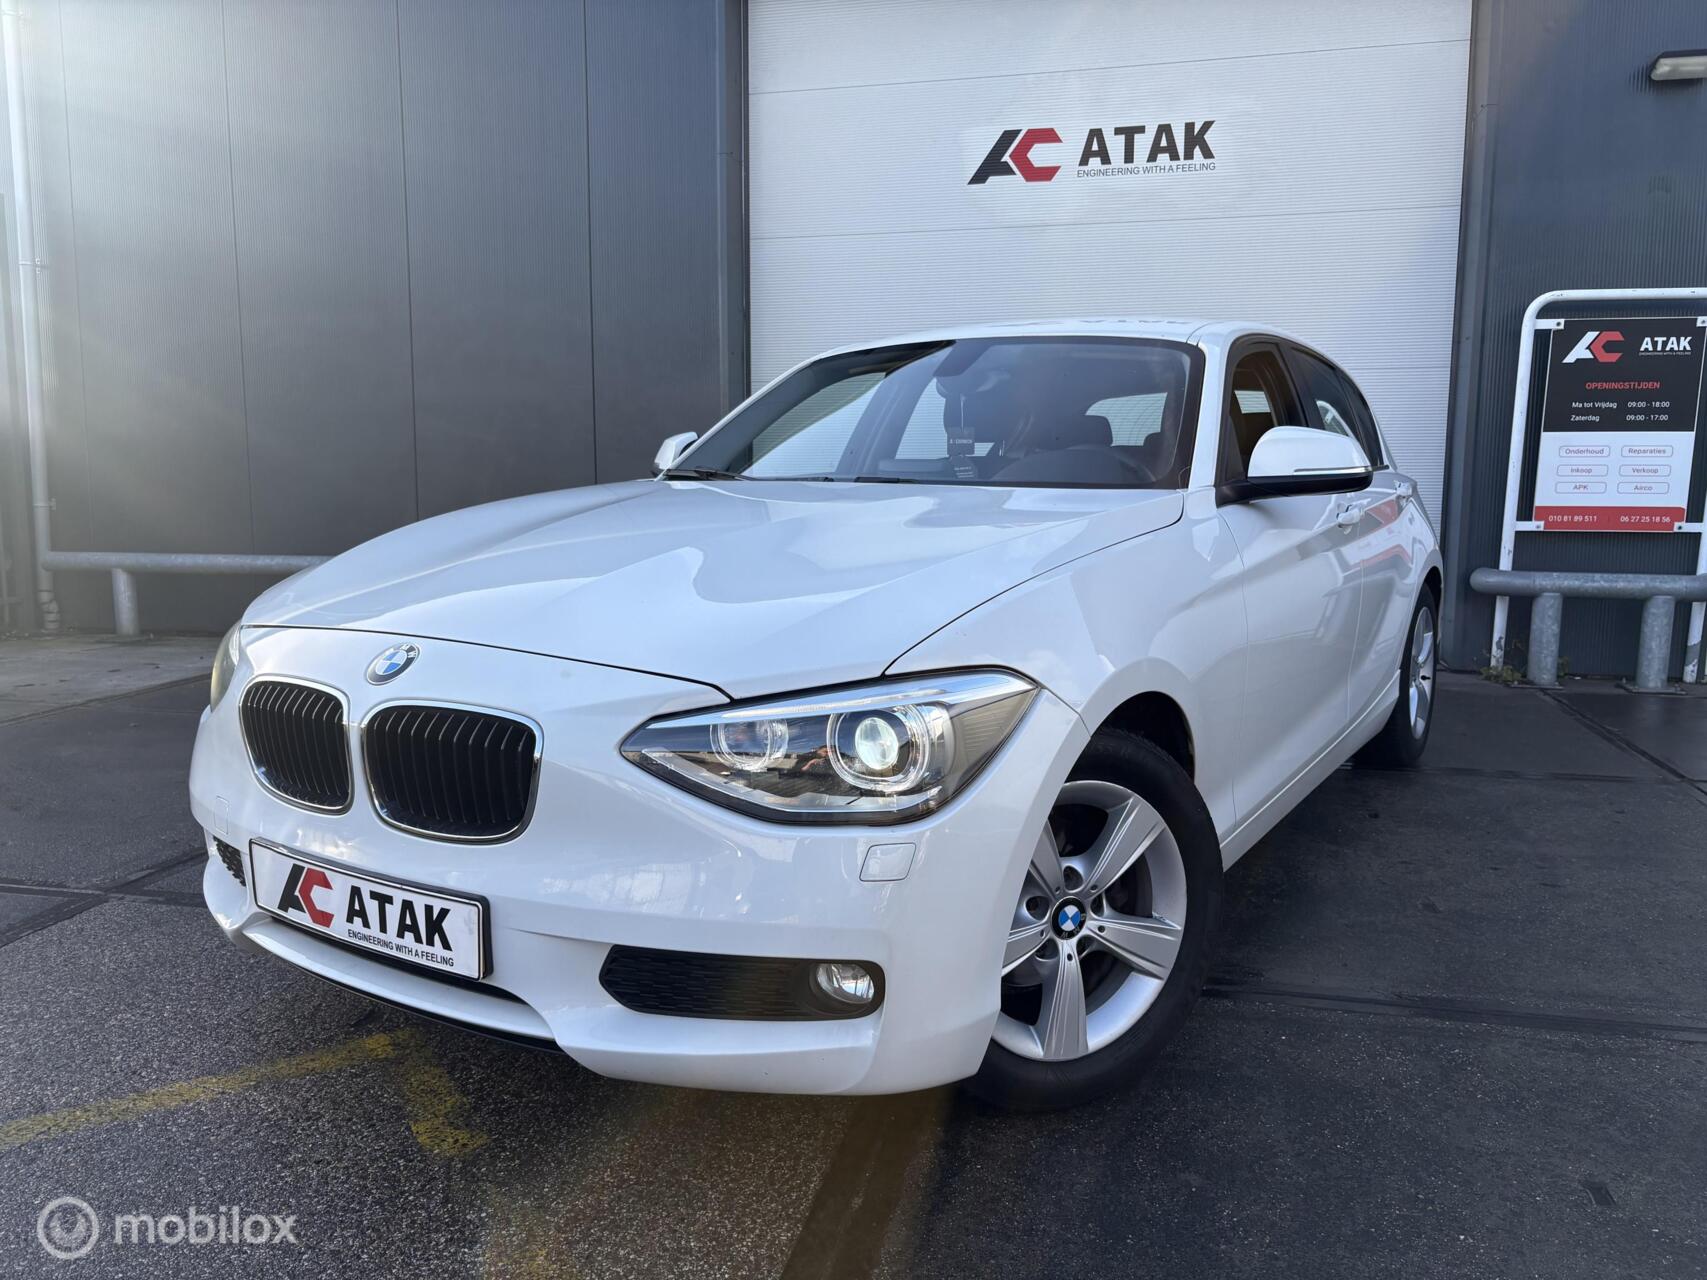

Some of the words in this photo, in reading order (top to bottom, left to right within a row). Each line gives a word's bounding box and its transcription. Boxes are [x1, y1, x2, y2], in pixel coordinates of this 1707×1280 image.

[1078, 120, 1216, 167] ATAK
[1077, 166, 1140, 178] ENGINEERING
[1142, 165, 1168, 175] WITH
[1168, 164, 1175, 173] A
[1176, 162, 1216, 172] FEELING
[1640, 336, 1692, 351] ATAK
[1585, 381, 1660, 390] OPENINGSTIJDEN
[1595, 401, 1617, 409] Vrijdag
[1571, 414, 1600, 422] Zaterdag
[1628, 447, 1666, 455] Reparaties
[346, 884, 453, 952] ATAK
[347, 929, 394, 951] ENGINEERING
[395, 943, 413, 957] WITH
[414, 947, 420, 958] A
[421, 948, 454, 967] FEELING
